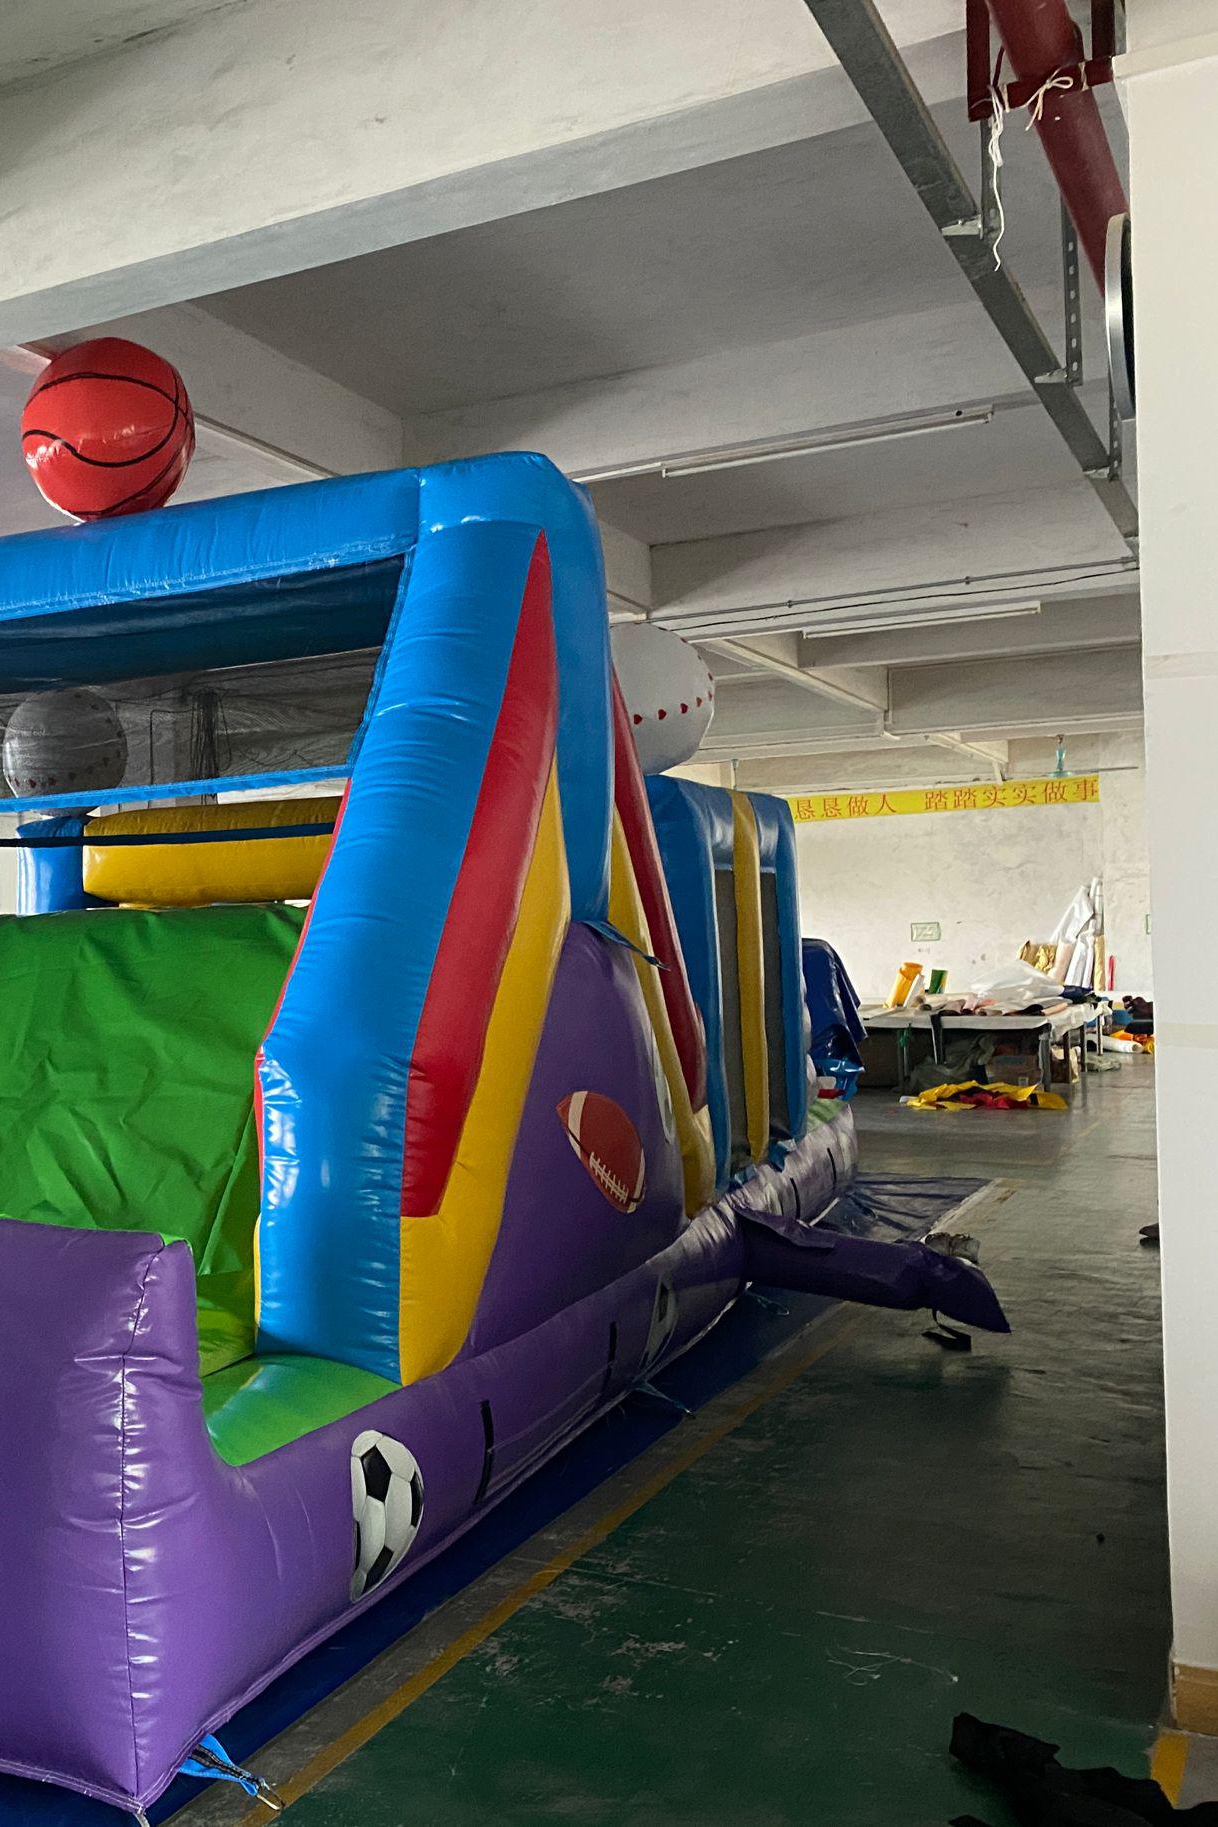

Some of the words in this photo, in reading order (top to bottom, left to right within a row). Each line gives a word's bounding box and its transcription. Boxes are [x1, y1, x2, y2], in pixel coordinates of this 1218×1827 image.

[795, 790, 897, 820] 恳恳做人
[924, 778, 1098, 811] 踏踏实实做事
